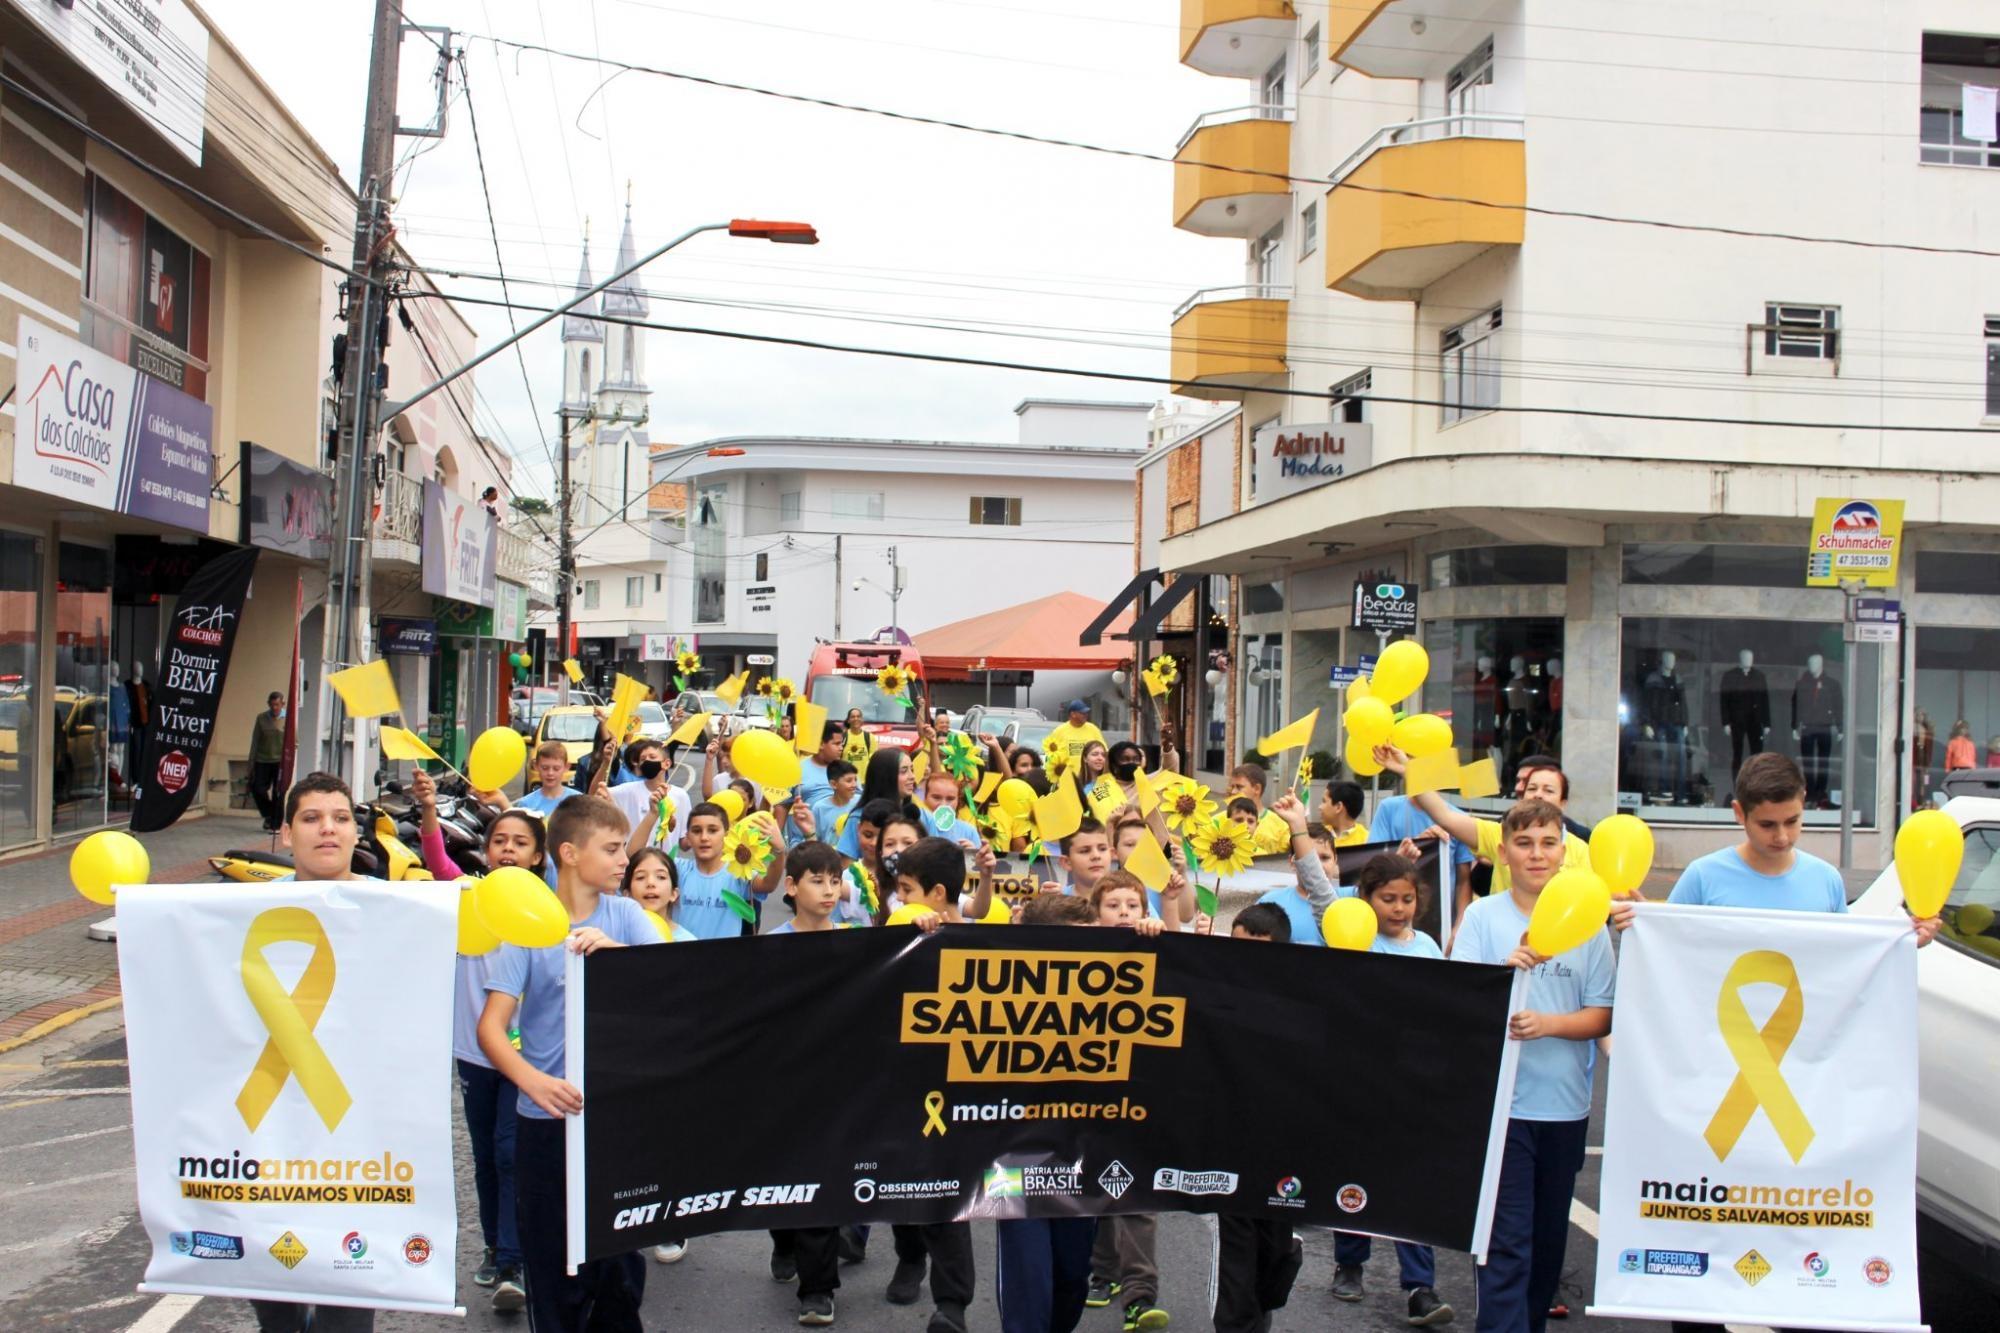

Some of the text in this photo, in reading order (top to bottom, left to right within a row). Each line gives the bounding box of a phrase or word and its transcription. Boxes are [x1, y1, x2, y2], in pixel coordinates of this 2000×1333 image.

[138, 351, 183, 386] EXCELLENCE
[65, 360, 114, 431] Casa
[42, 414, 111, 465] dos Colchões
[1281, 455, 1344, 477] Modas
[1818, 534, 1893, 549] Schuhmacher
[1839, 555, 1889, 566] 47 3533-1126
[1363, 595, 1415, 612] Beatriz
[183, 627, 222, 641] COLCHÕES
[399, 631, 432, 642] FRITZ
[170, 648, 219, 670] Dormir
[166, 665, 218, 694] BEM
[832, 667, 881, 675] EMERGÊNC
[160, 705, 209, 733] Viver
[163, 761, 188, 777] INER
[948, 958, 1145, 996] JUNTOS
[910, 999, 1175, 1039] SALVAMOS
[960, 1039, 1120, 1074] VIDAS!
[952, 1097, 1147, 1121] maioamarelo
[179, 1150, 414, 1182] maioamarelo
[854, 1162, 878, 1171] APOIO
[1024, 1165, 1052, 1175] PÁTRIA
[879, 1179, 960, 1193] OBSERVATÓRIO
[1024, 1175, 1083, 1190] BRASIL
[1183, 1173, 1230, 1184] PREFEITURA
[184, 1185, 411, 1203] JUNTOS SALVAMOS VIDAS!
[613, 1184, 659, 1200] REALIZAÇÃO
[1641, 1177, 1874, 1207] maioamarelo
[613, 1183, 821, 1230] CNT SEST SENAT
[1645, 1205, 1870, 1227] JUNTOS SALVAMOS VIDAS!
[1649, 1251, 1700, 1264] PREFEITURA
